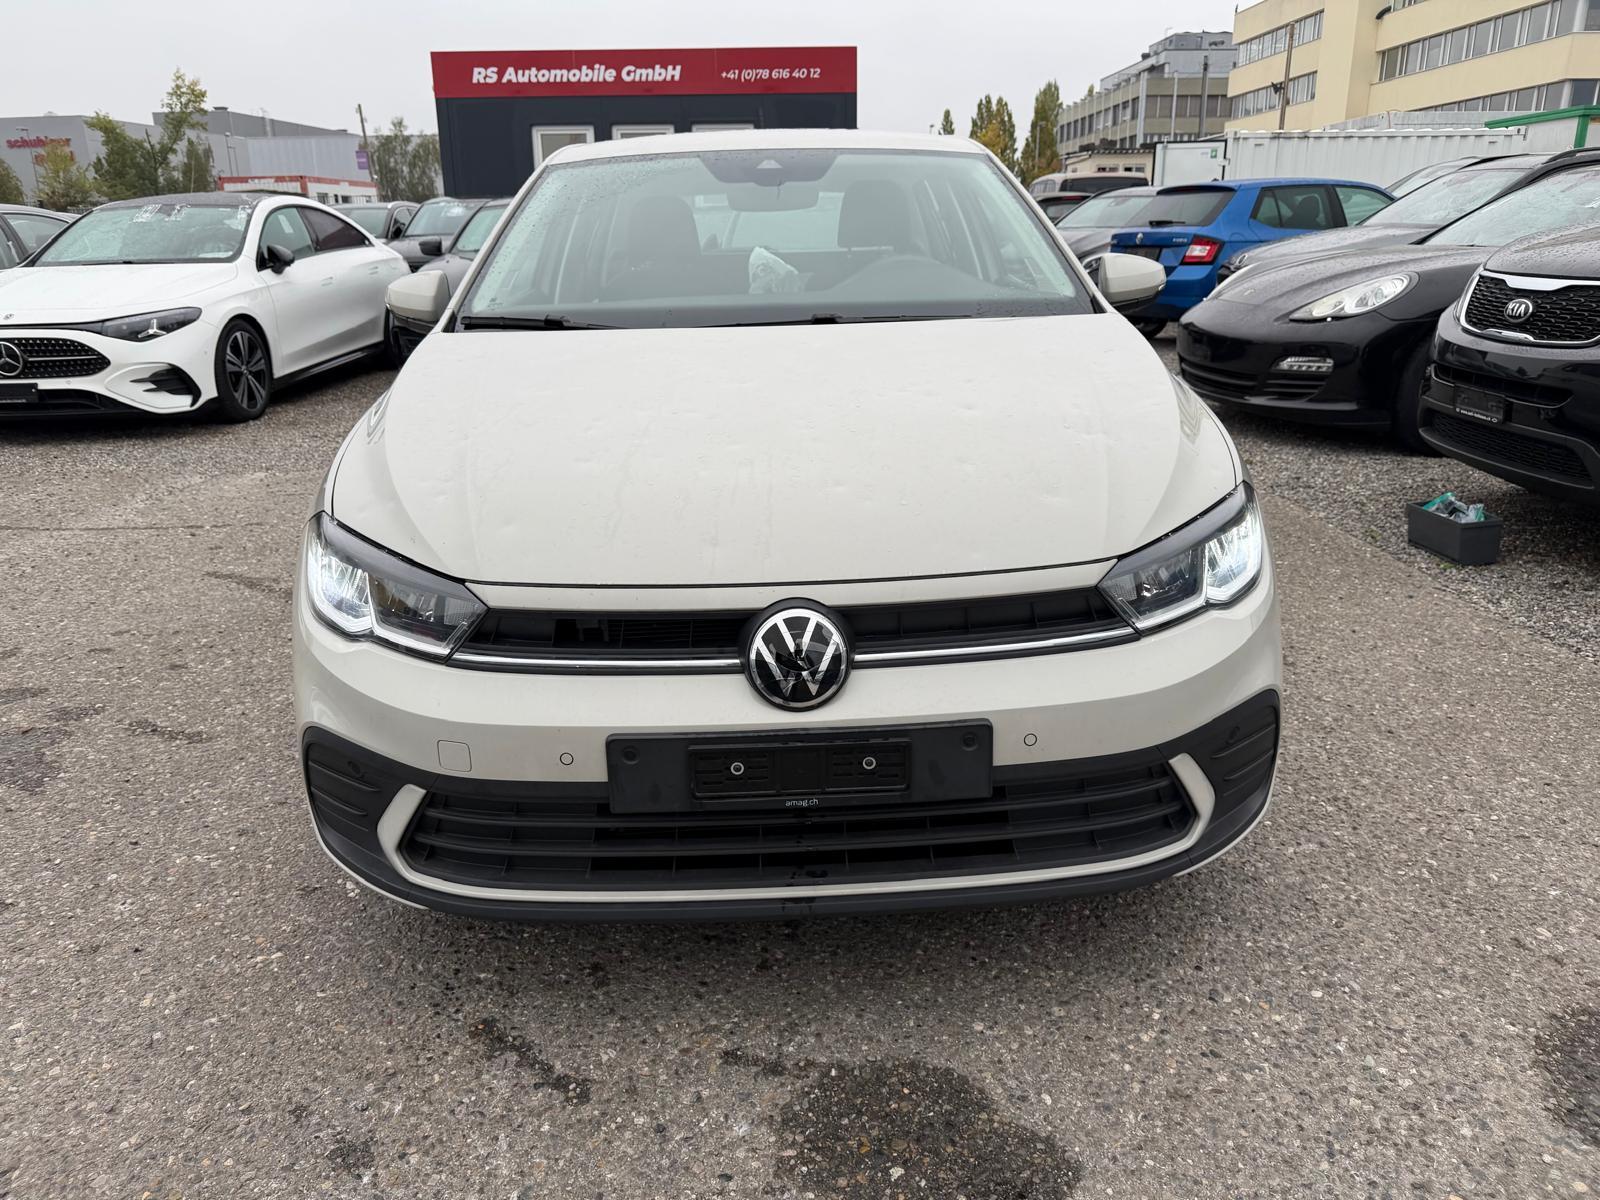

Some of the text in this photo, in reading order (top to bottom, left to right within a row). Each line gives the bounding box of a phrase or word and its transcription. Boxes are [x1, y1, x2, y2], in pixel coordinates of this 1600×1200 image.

[472, 64, 682, 84] RS Automobile GmbH
[720, 68, 821, 83] +41 (0)78 616 40 12
[785, 797, 819, 808] amag.ch
